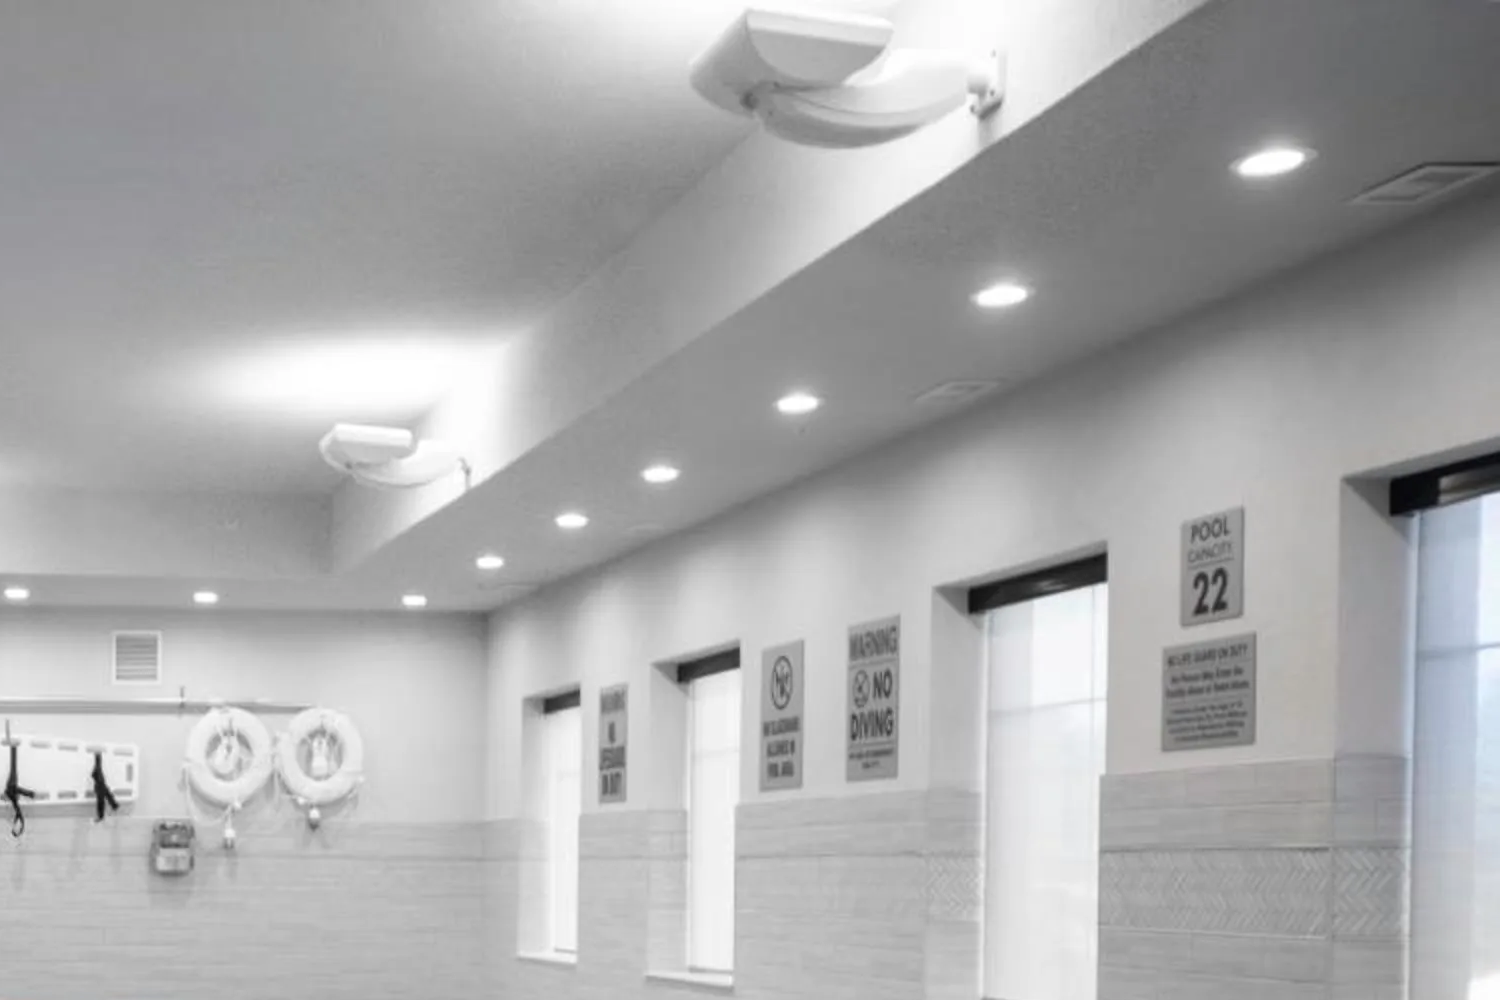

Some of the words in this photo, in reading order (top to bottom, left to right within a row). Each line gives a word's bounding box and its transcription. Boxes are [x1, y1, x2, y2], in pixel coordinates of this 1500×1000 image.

[1190, 516, 1231, 544] POOL
[1192, 567, 1228, 616] 22
[850, 625, 898, 661] WARNING
[873, 668, 893, 699] NO
[851, 707, 893, 741] DIVING
